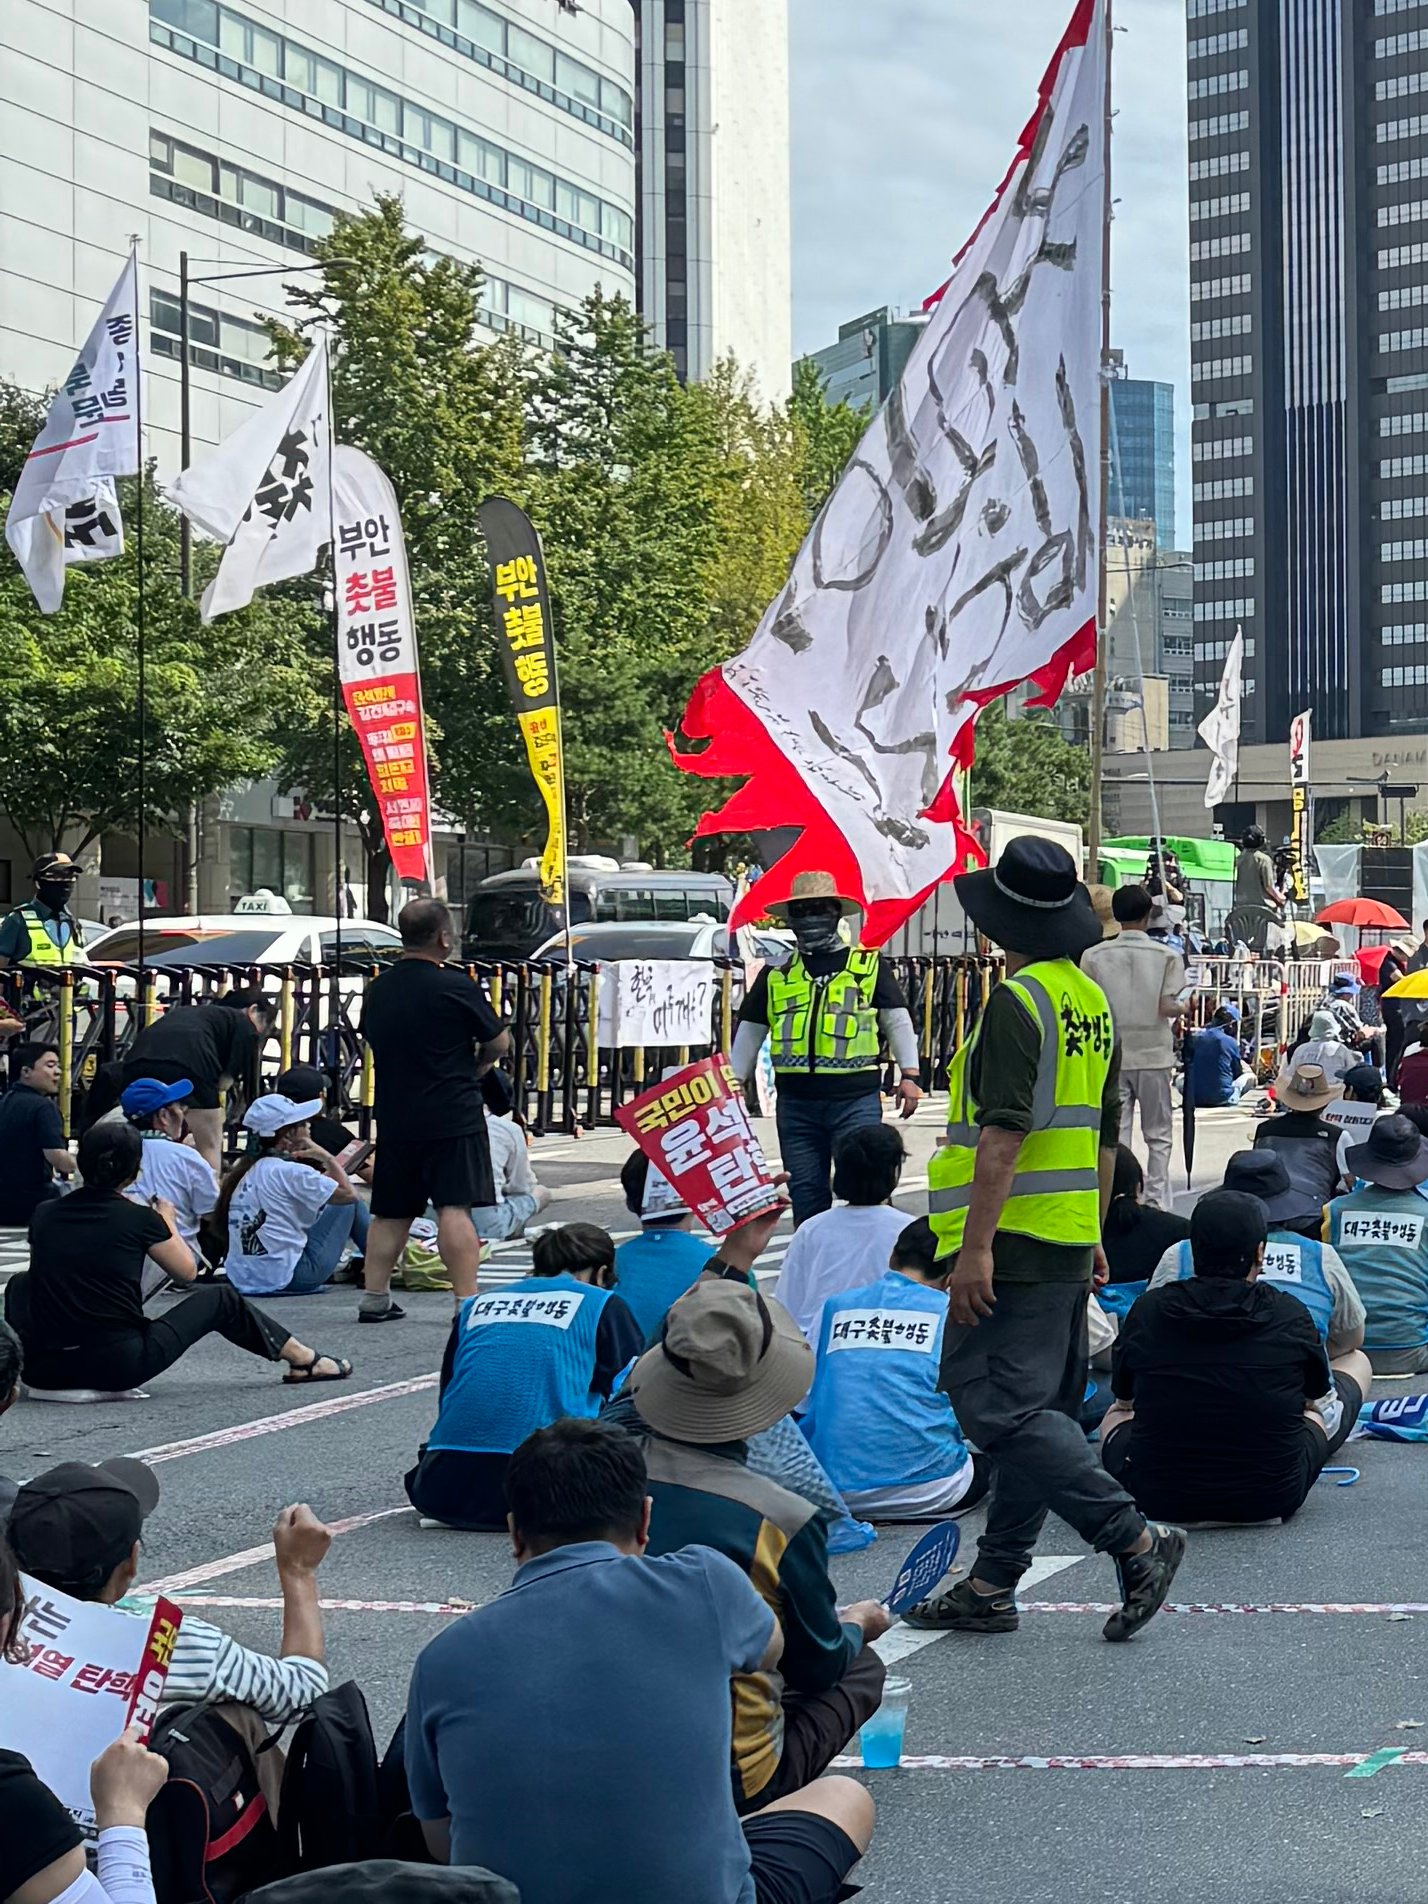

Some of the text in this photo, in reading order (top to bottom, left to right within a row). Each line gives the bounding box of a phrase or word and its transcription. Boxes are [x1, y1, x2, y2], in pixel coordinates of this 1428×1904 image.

[339, 515, 391, 559] 부안
[346, 566, 398, 616] 촛불
[496, 555, 539, 602] 부안
[347, 619, 402, 666] 행동
[503, 604, 544, 651] 촛불
[514, 649, 549, 697] 행동
[242, 902, 267, 911] TAXI
[634, 1070, 722, 1134] 국민이
[661, 1096, 754, 1177] 윤석
[1344, 1218, 1418, 1242] 대구촛불행동
[472, 1298, 572, 1320] 대구촛불행동
[832, 1313, 929, 1346] 대구촛불행동
